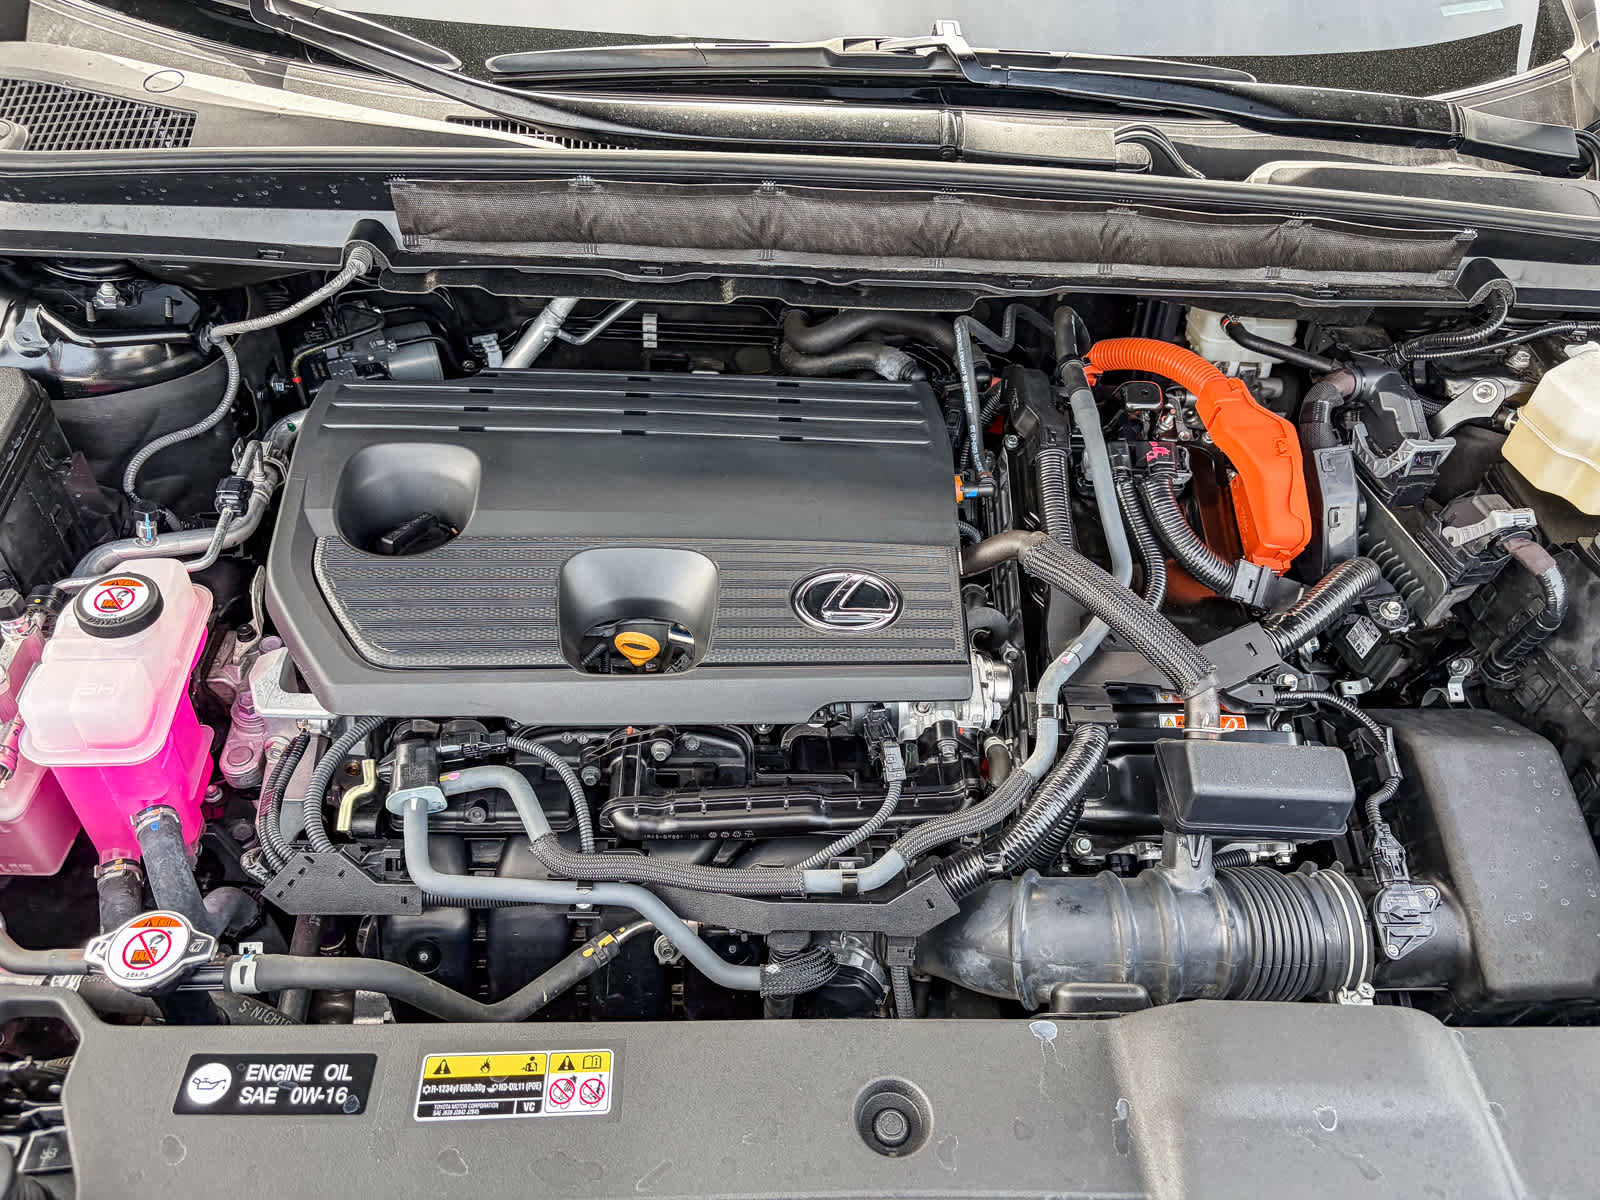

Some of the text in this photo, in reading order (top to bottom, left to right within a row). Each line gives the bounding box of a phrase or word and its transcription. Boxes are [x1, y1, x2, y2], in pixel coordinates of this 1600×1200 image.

[245, 1063, 353, 1082] ENGINE OIL
[239, 1086, 349, 1105] SAE 0W-16
[523, 1101, 536, 1112] VC
